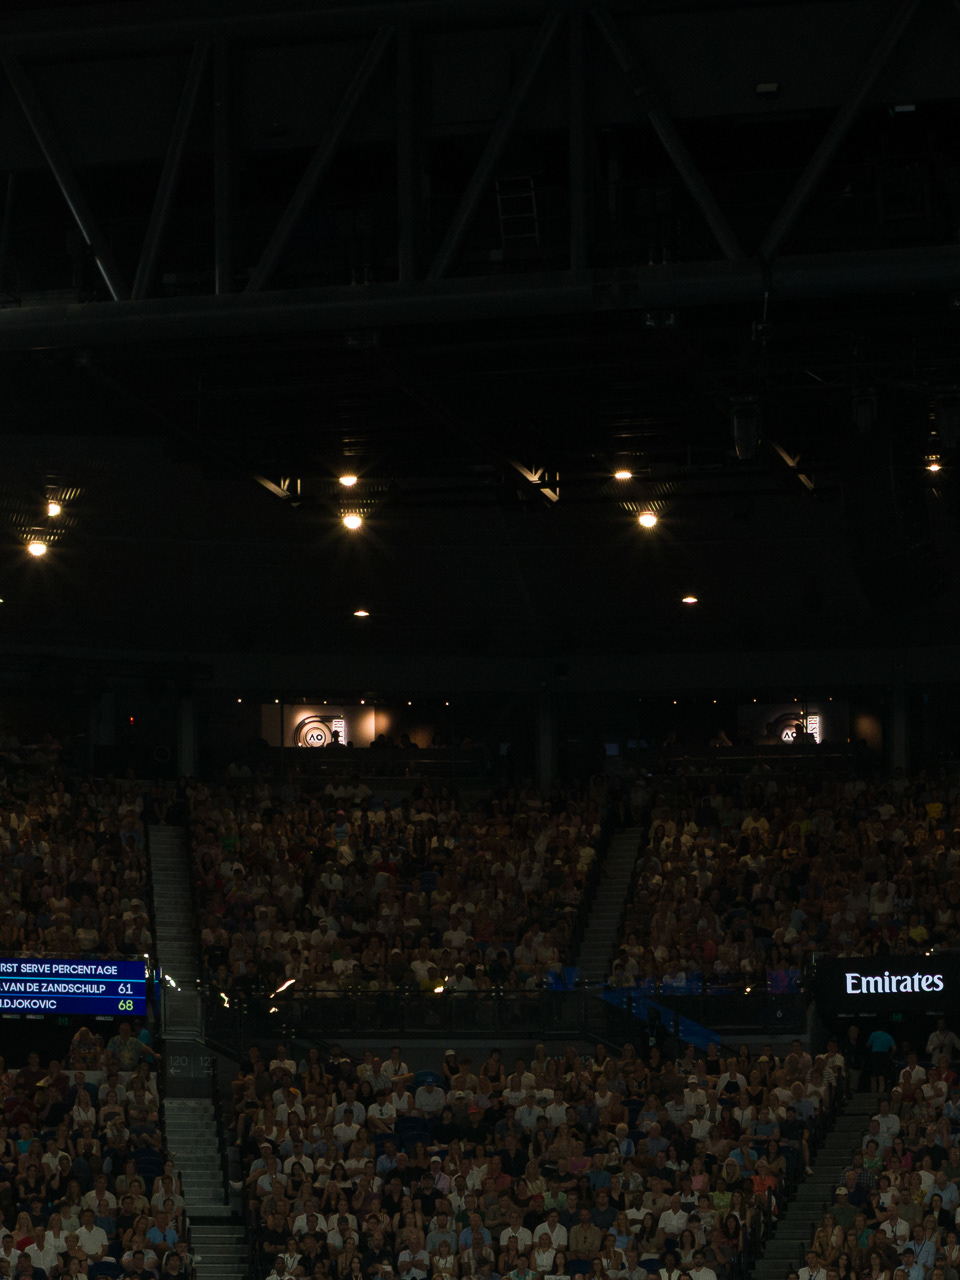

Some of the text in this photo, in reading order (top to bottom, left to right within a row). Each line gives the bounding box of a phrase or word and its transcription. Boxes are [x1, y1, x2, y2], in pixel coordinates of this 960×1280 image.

[308, 733, 324, 741] AO
[20, 963, 51, 974] SERVE
[52, 964, 118, 975] PERCENTAGE
[26, 982, 39, 992] DE
[41, 983, 106, 994] ZANDSCHULP
[118, 983, 133, 994] 61
[844, 970, 945, 995] Emirates
[118, 999, 134, 1011] 68
